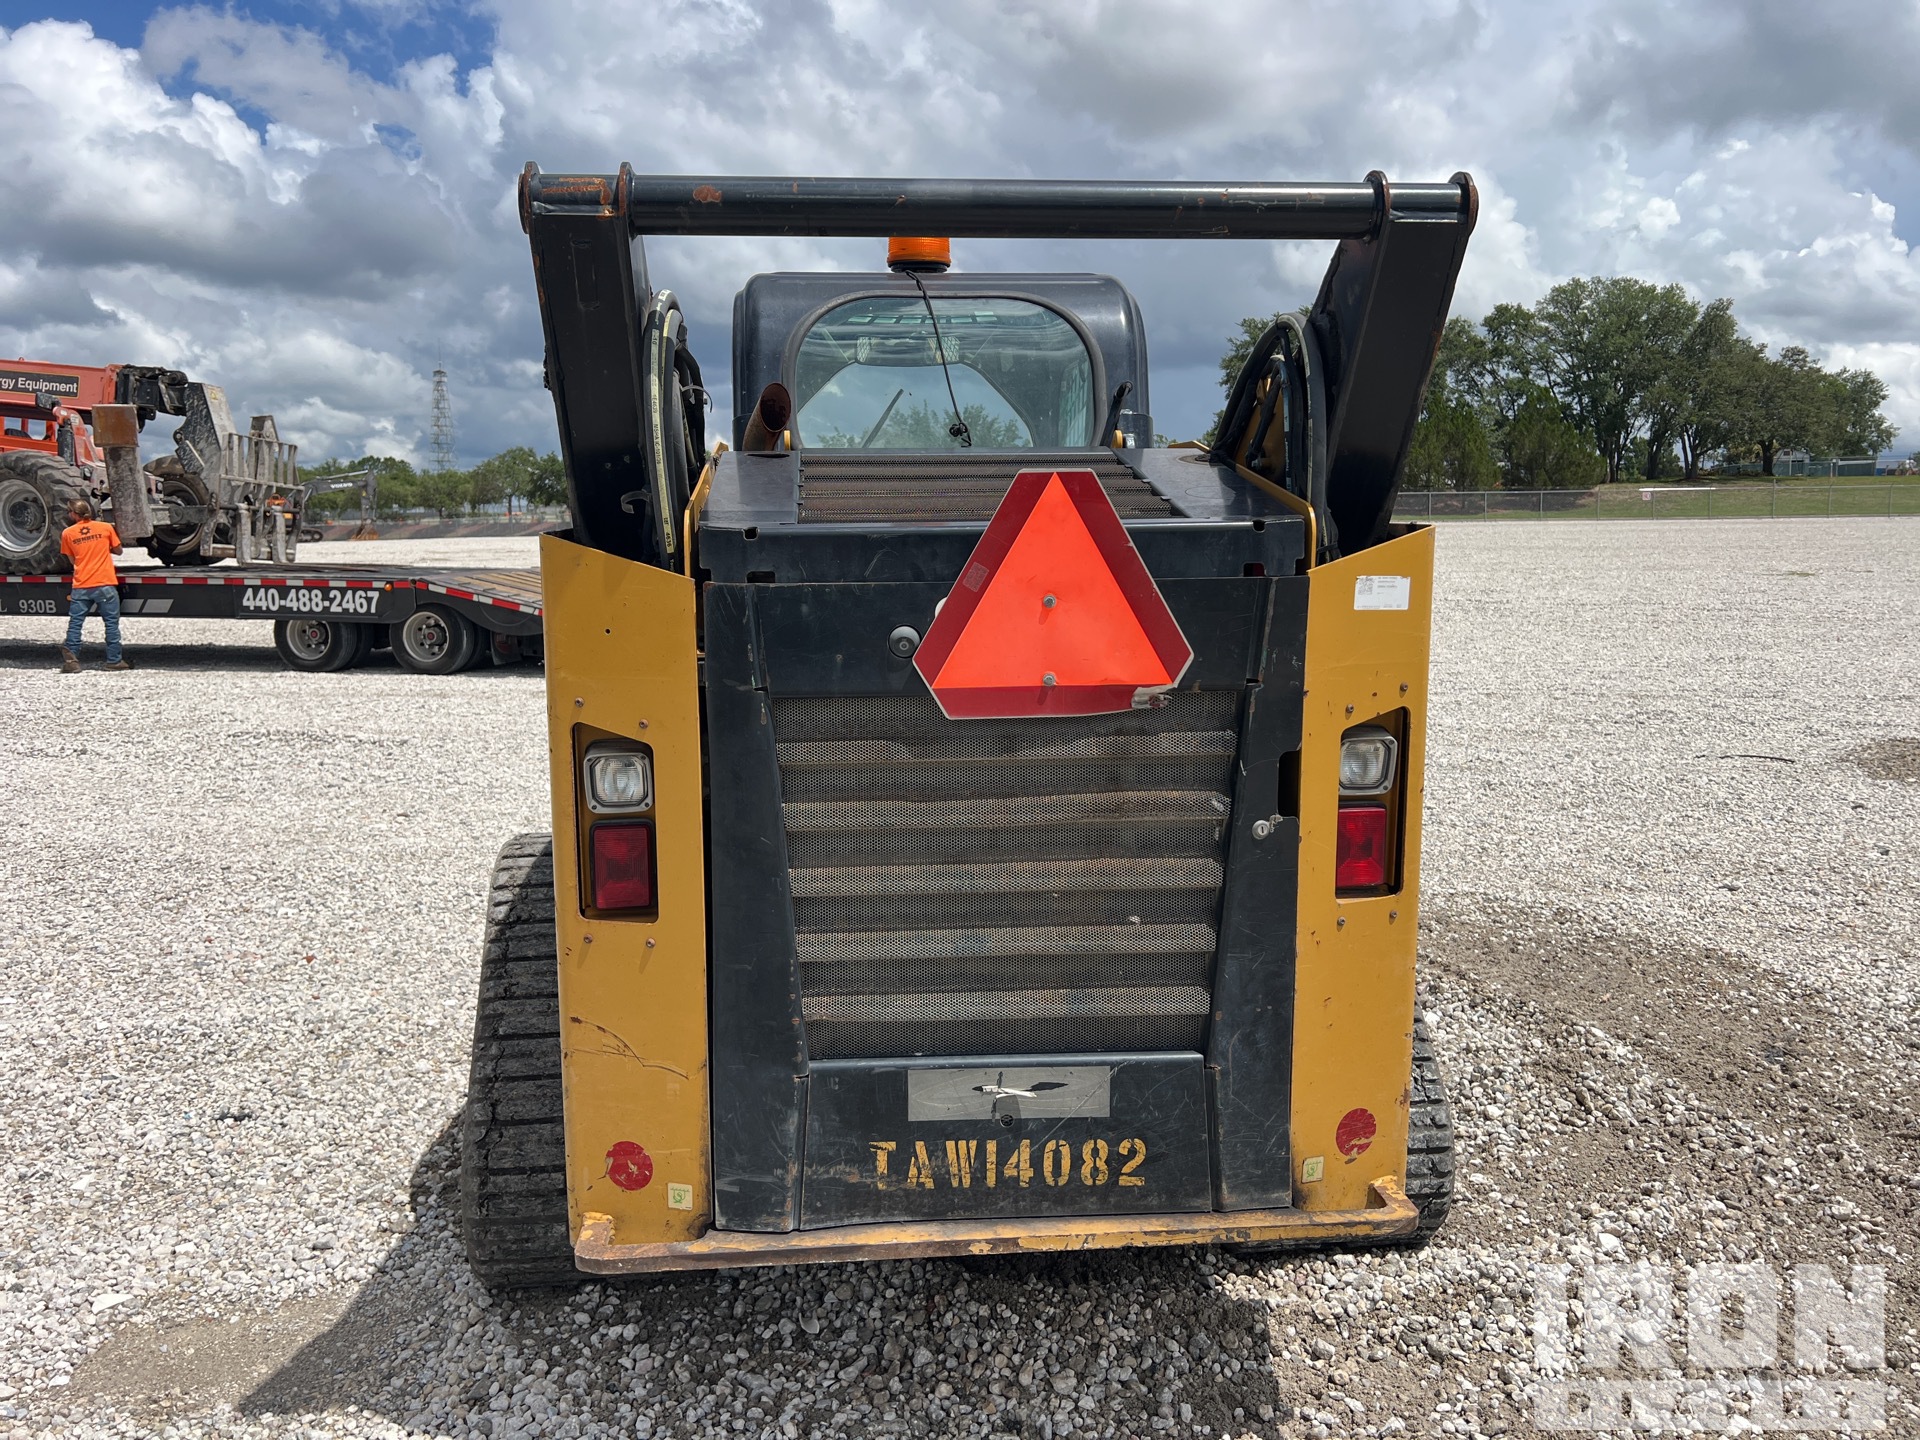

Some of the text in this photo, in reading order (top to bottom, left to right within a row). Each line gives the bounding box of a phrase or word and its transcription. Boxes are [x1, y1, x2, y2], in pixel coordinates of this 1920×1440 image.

[18, 377, 78, 393] Equipment
[19, 599, 57, 613] 930B
[242, 587, 380, 614] 440-488-2467
[868, 1138, 1147, 1190] TAW14082
